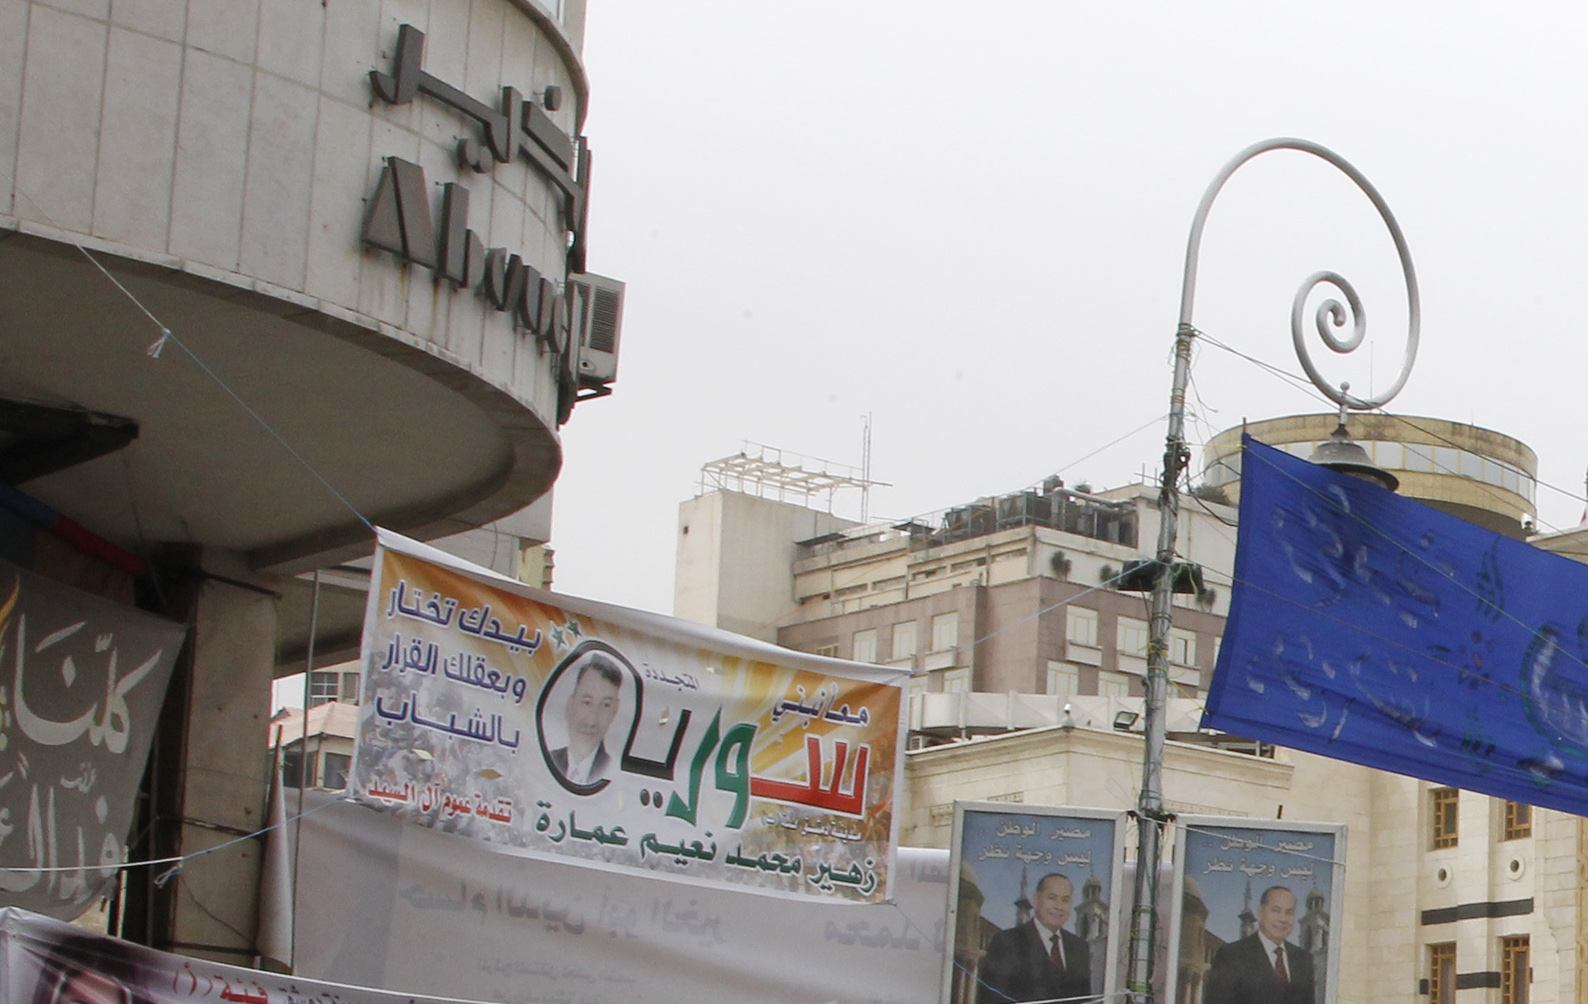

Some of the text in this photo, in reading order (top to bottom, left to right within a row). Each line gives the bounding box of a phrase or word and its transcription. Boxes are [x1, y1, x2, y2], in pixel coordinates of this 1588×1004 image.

[388, 581, 542, 655] بيدك تختار
[382, 634, 528, 703] وبعقلك القرار
[376, 692, 520, 754] بالشباب
[535, 799, 629, 846] عمارة
[640, 831, 717, 866] نعيم
[726, 842, 802, 875] محمد
[807, 858, 877, 895] زهير
